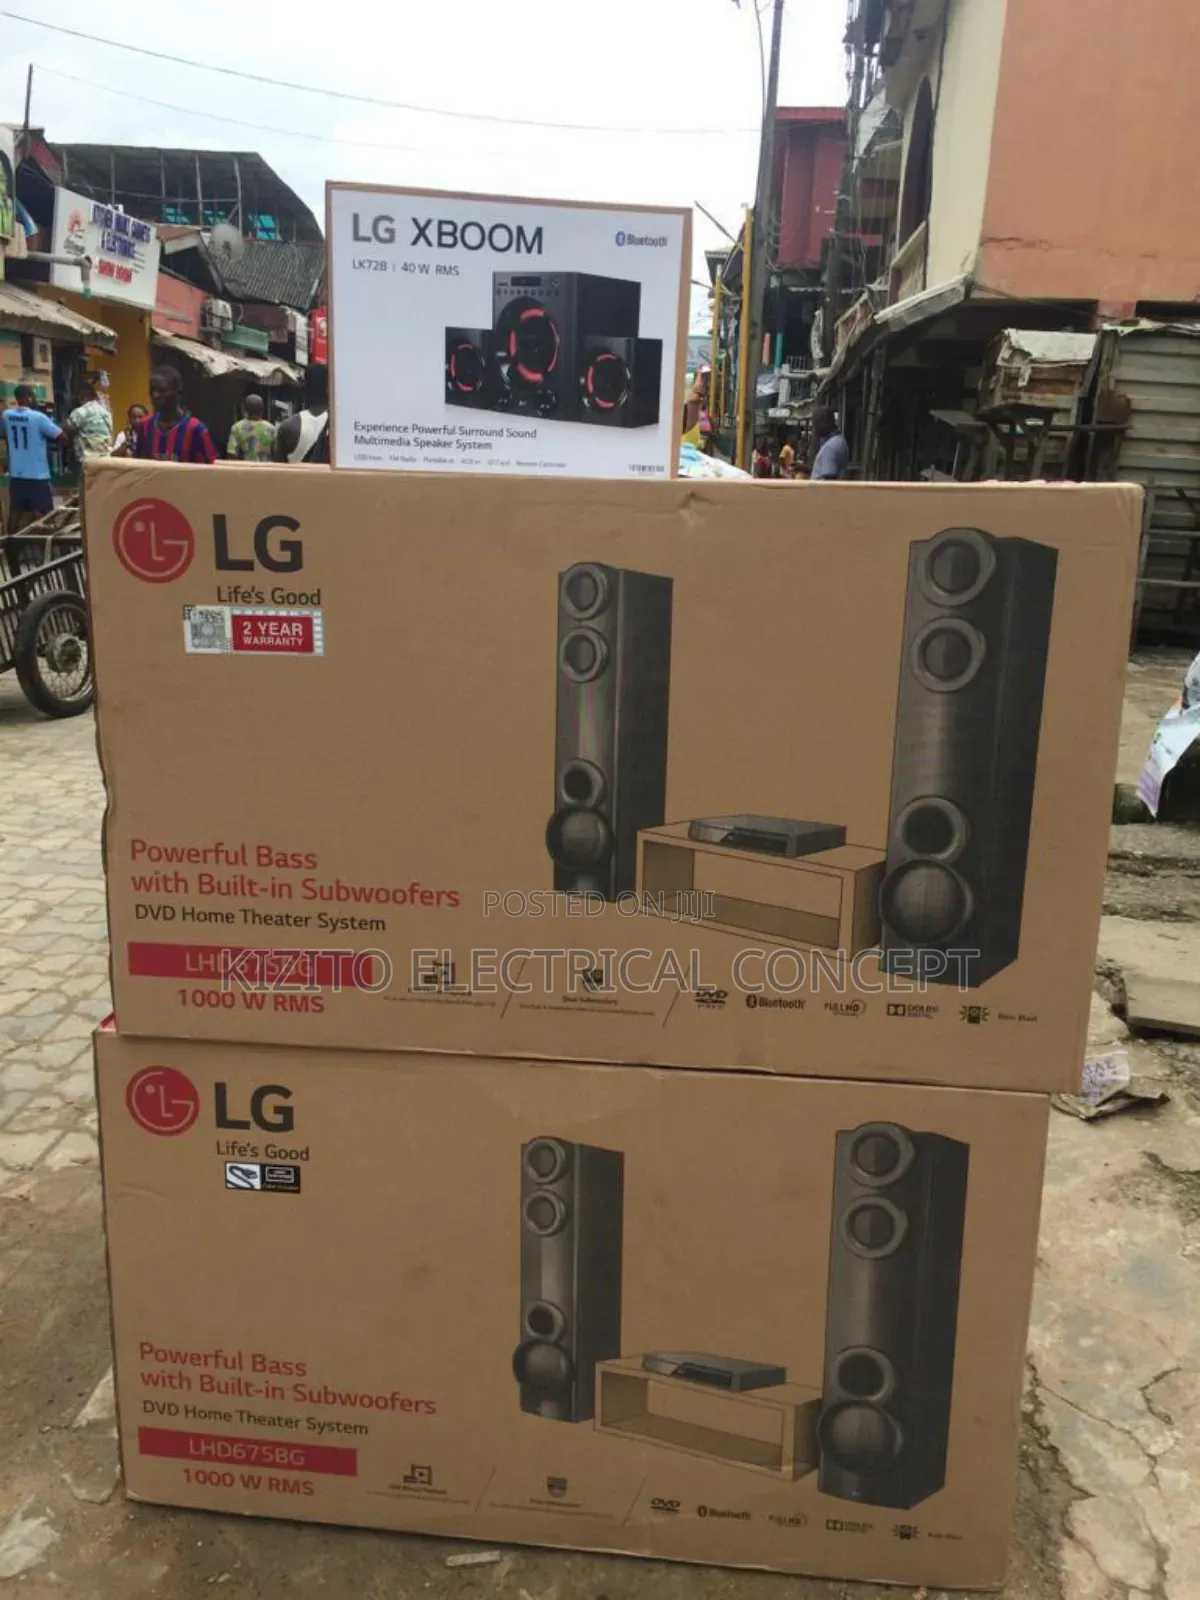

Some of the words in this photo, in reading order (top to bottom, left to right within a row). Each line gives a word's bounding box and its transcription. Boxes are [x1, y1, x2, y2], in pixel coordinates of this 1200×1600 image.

[352, 212, 396, 244] LG
[410, 217, 543, 254] XBOOM
[626, 232, 668, 247] Bluetooth
[401, 261, 416, 273] 40
[417, 263, 430, 274] W
[435, 264, 460, 276] RMS
[12, 425, 28, 450] 11
[354, 421, 409, 435] Experience
[412, 423, 455, 436] Powerful
[459, 425, 504, 437] Surround
[506, 427, 537, 438] Sound
[354, 435, 410, 447] Multimedia
[413, 437, 452, 449] Speaker
[455, 438, 493, 451] System
[212, 514, 303, 573] LG
[216, 585, 265, 604] Life's
[271, 588, 321, 606] Good
[242, 636, 304, 646] WARRANTY
[243, 621, 252, 635] 2
[257, 622, 303, 636] YEAR
[130, 839, 247, 867] Powerful
[257, 846, 318, 870] Bass
[131, 871, 188, 895] with
[198, 873, 292, 899] Built-in
[302, 878, 460, 908] Subwoofers
[135, 904, 175, 921] DVD
[182, 907, 235, 924] Home
[239, 909, 311, 928] Theater
[317, 913, 386, 933] System
[178, 989, 235, 1009] 1000
[240, 992, 265, 1010] W
[273, 994, 325, 1013] RMS
[758, 996, 805, 1009] Bluetooth
[214, 1082, 294, 1133] LG
[216, 1141, 259, 1158] Life's
[265, 1143, 309, 1161] Good
[139, 1342, 243, 1371] Powerful
[251, 1353, 307, 1377] Bass
[140, 1370, 191, 1392] with
[199, 1373, 285, 1400] Built-in
[293, 1383, 437, 1415] Subwoofers
[143, 1400, 179, 1417] DVD
[185, 1404, 232, 1422] Home
[239, 1410, 301, 1430] Theater
[306, 1417, 368, 1436] System
[189, 1438, 305, 1466] LHD675BG
[183, 1468, 235, 1488] 1000
[239, 1473, 262, 1490] W
[268, 1477, 315, 1496] RMS
